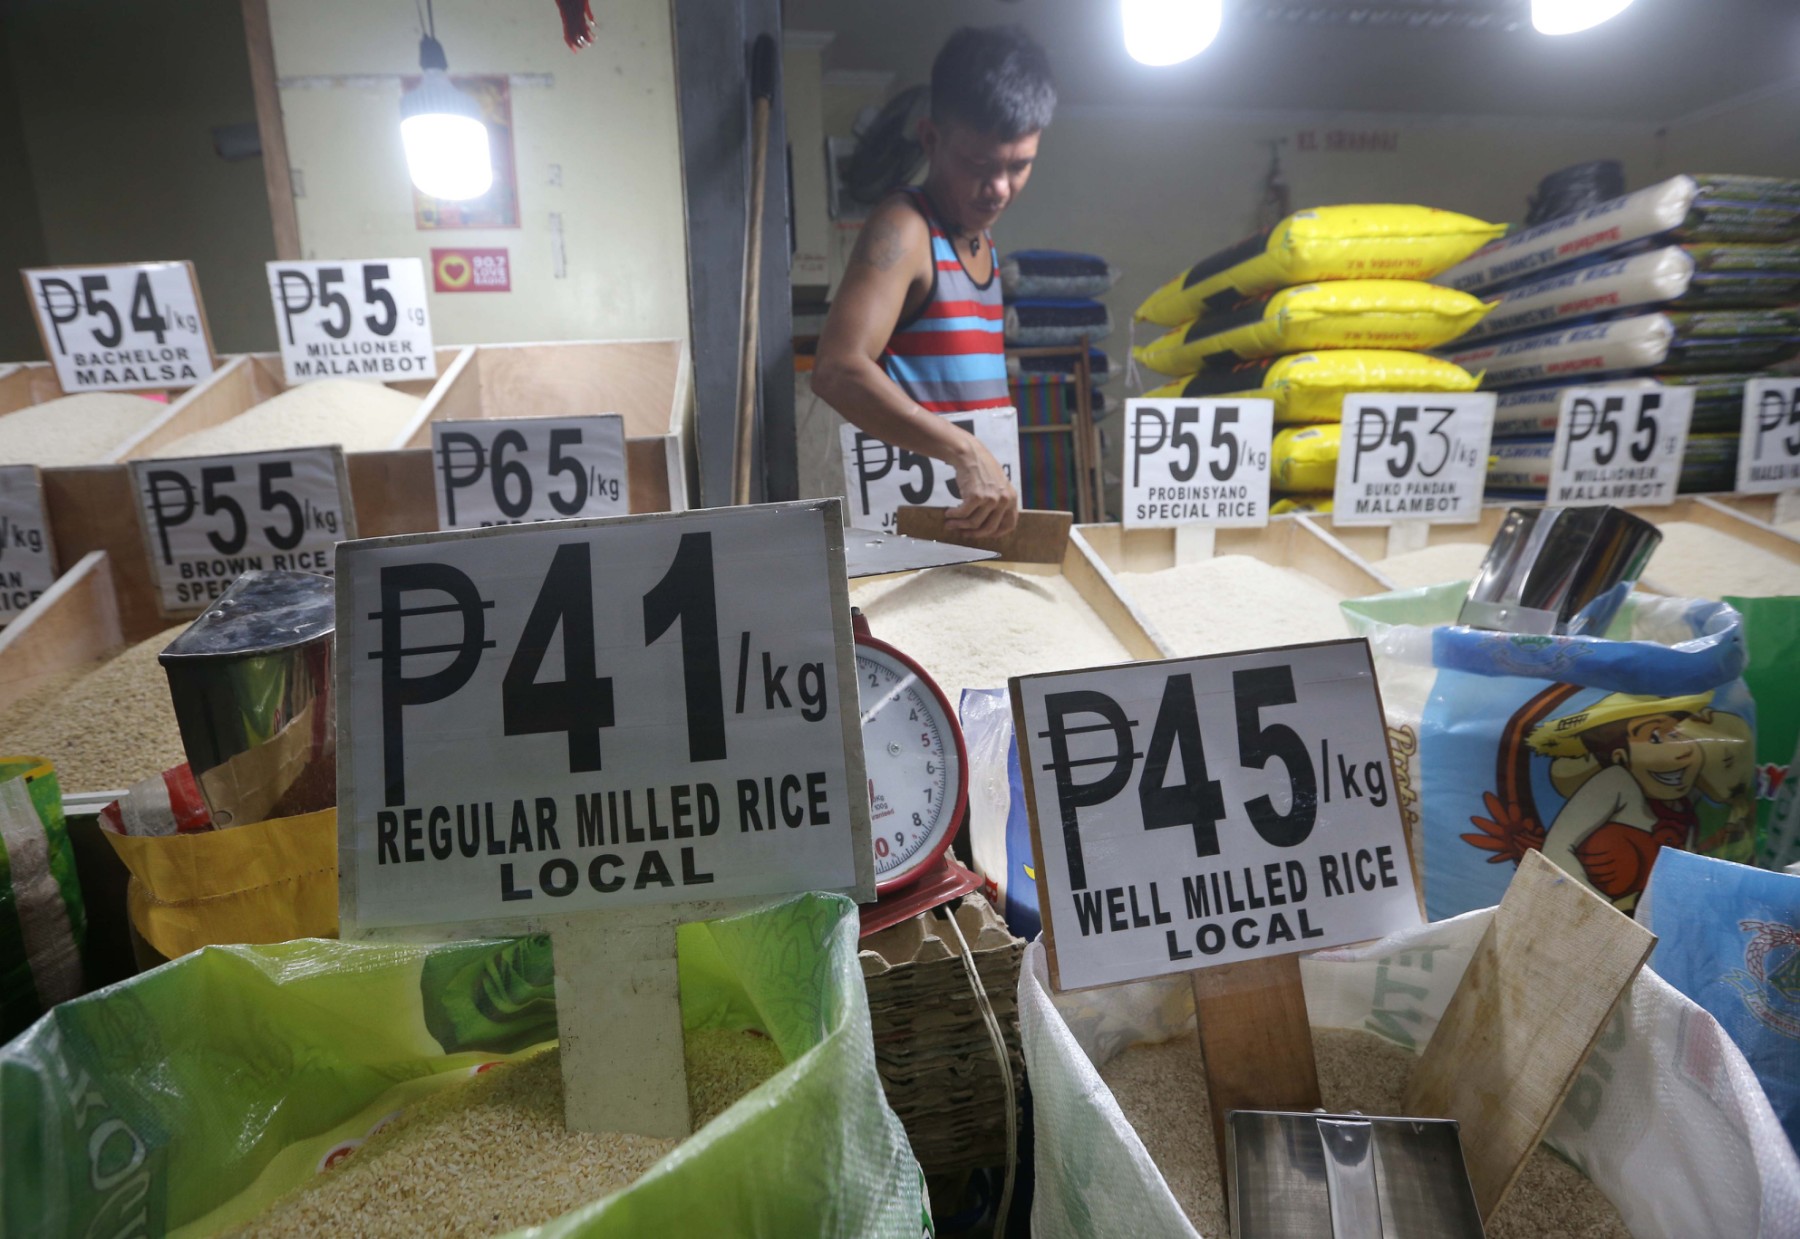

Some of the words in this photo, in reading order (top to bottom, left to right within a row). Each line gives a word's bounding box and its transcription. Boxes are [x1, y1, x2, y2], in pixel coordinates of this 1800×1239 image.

[306, 341, 413, 356] MILLIONER
[74, 348, 190, 367] BACHELOR
[294, 356, 427, 376] MALAMBOT
[75, 365, 197, 385] MAALSA
[1148, 486, 1248, 501] PROBINSYANO
[1365, 483, 1402, 496] BUKO
[1406, 482, 1456, 495] PANDAN
[1559, 483, 1665, 500] MALAMBOT
[1136, 503, 1210, 519] SPECIAL
[1217, 502, 1257, 518] RICE
[1355, 497, 1460, 514] MALAMBOT
[180, 556, 262, 579] BROWN
[273, 551, 327, 571] RICE
[868, 674, 879, 688] 2
[909, 707, 918, 721] 4
[921, 732, 930, 747] 5
[926, 761, 935, 775] 6
[923, 788, 932, 803] 7
[377, 796, 561, 865] REGULAR
[577, 782, 720, 848] MILLED
[737, 771, 830, 833] RICE
[912, 812, 922, 826] 8
[895, 832, 904, 847] 9
[500, 846, 714, 901] LOCAL
[1073, 881, 1171, 936] WELL
[1182, 859, 1307, 919] MILLED
[1319, 845, 1398, 897] RICE
[1166, 908, 1324, 961] LOCAL
